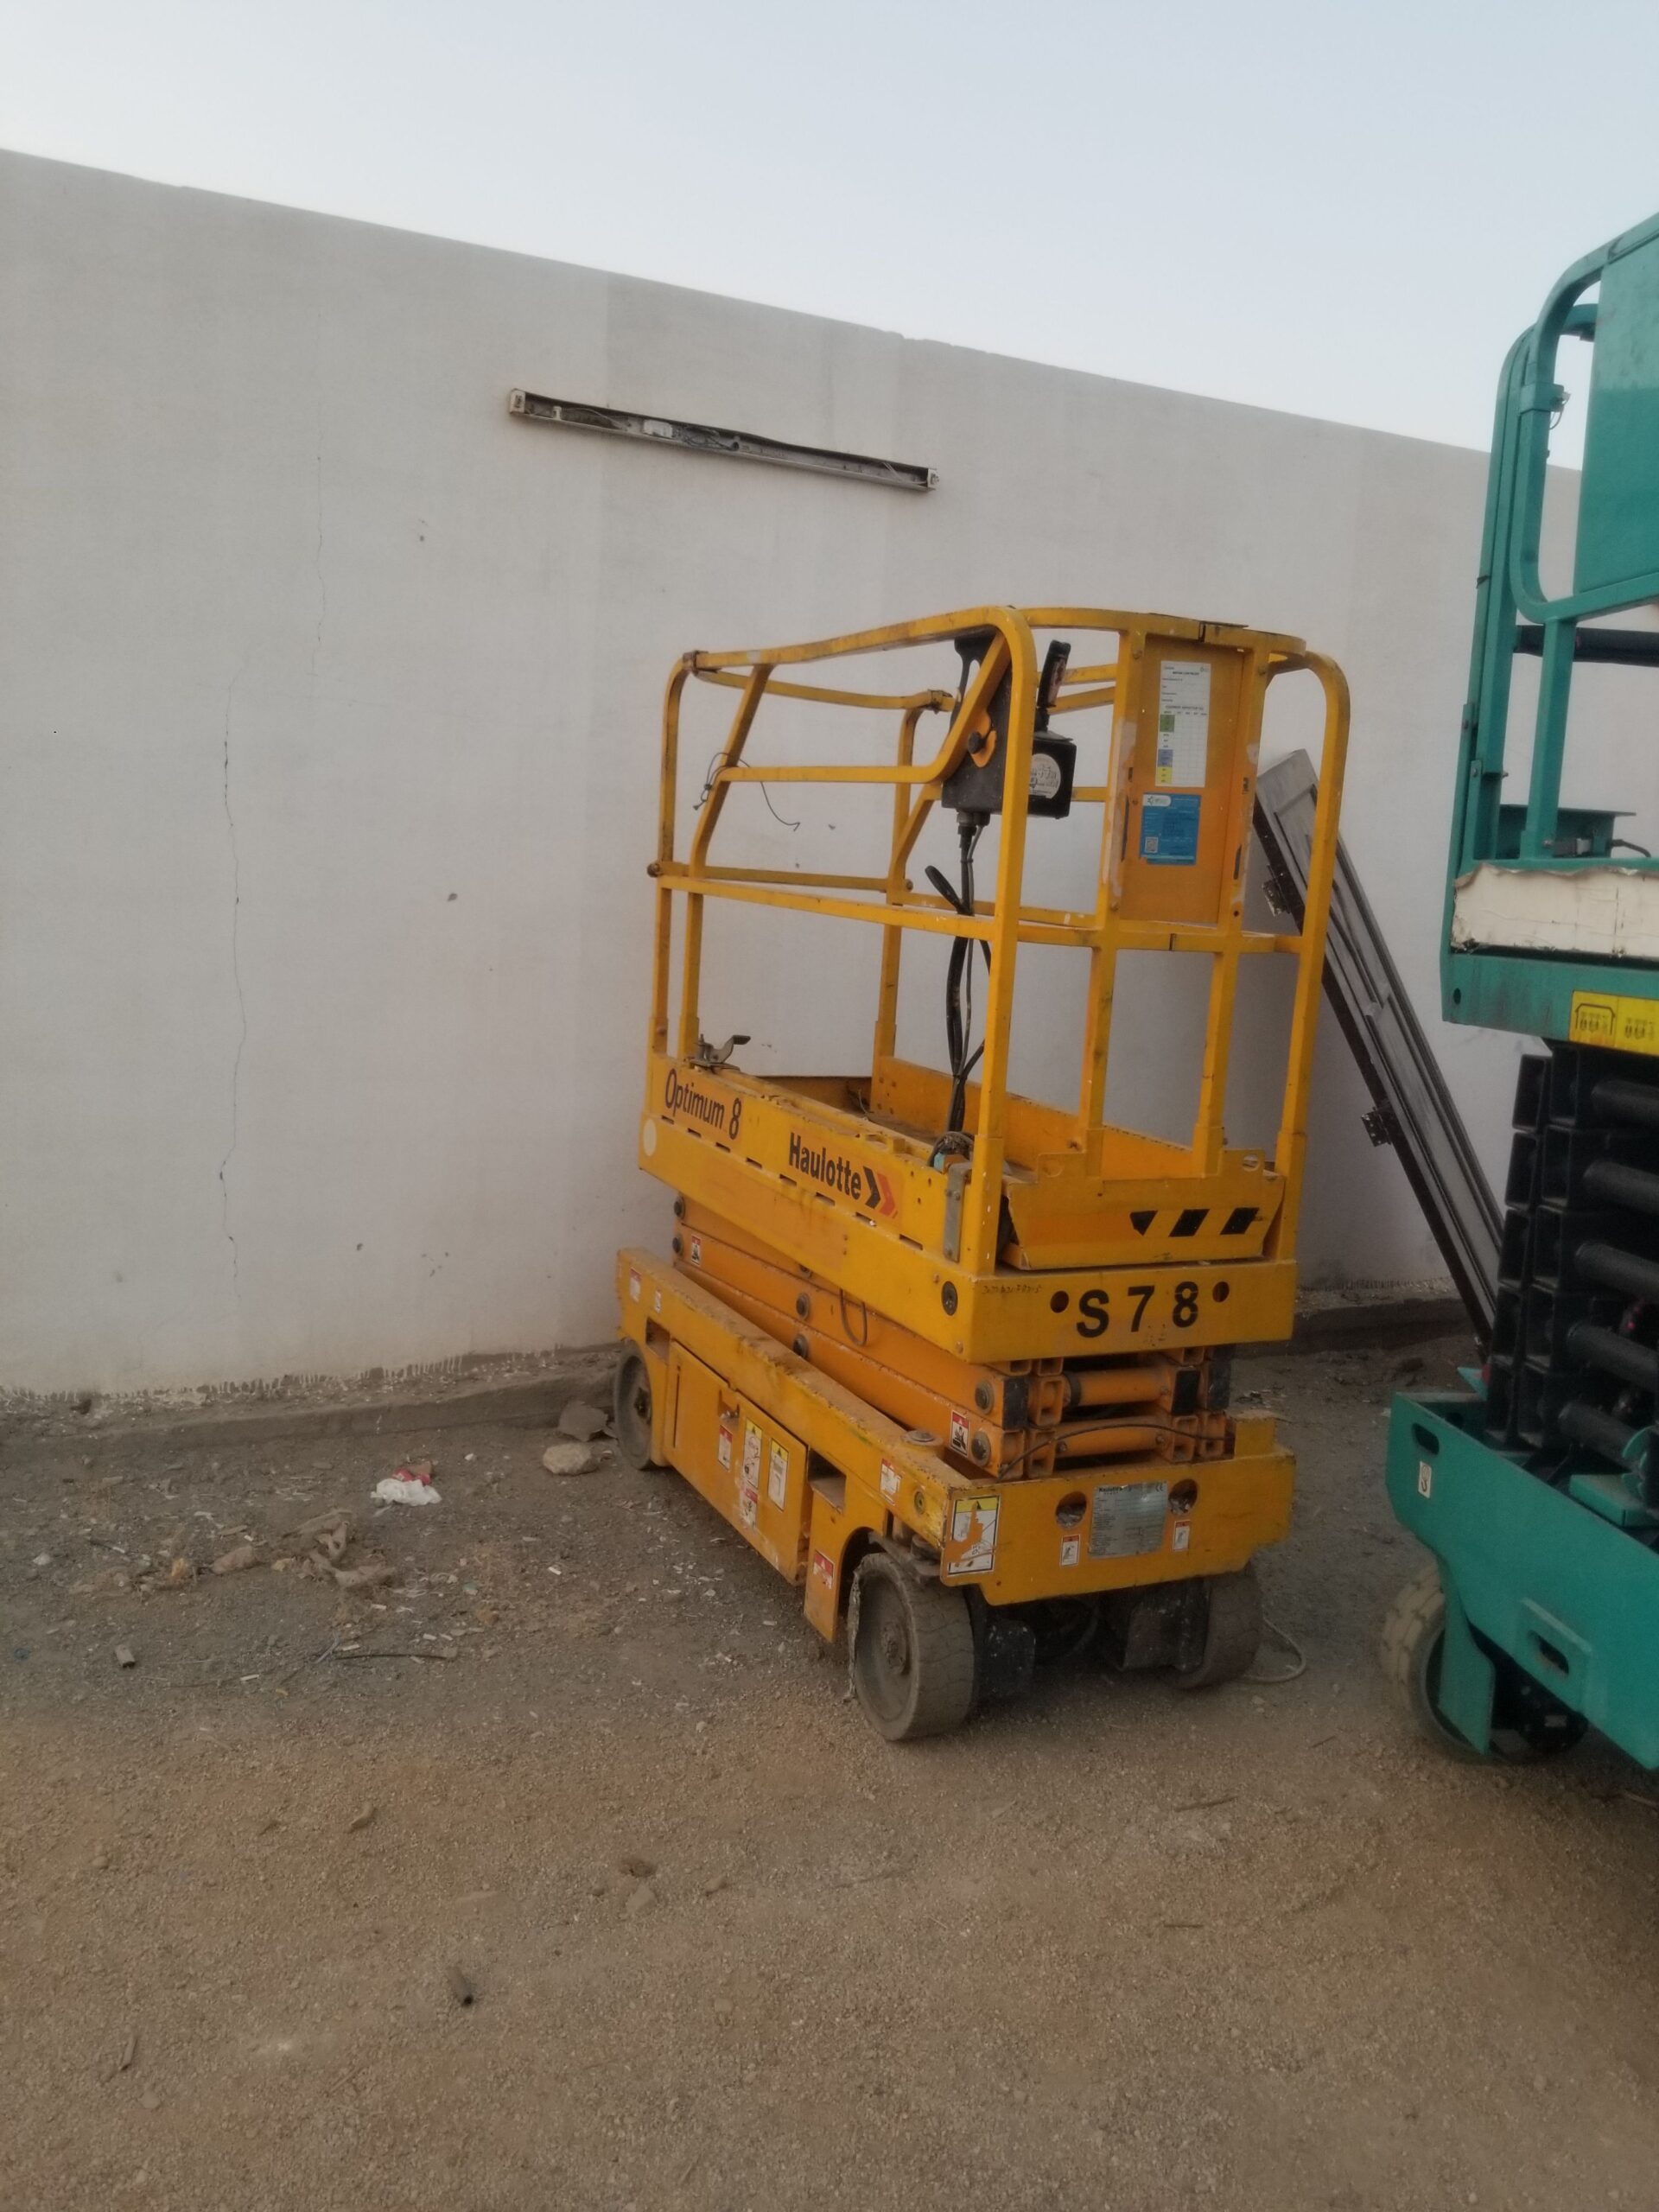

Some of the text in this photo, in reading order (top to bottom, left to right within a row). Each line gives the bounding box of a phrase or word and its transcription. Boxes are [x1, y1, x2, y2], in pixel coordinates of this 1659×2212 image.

[665, 1068, 742, 1140] Optimum 8
[789, 1132, 861, 1200] Haulotte
